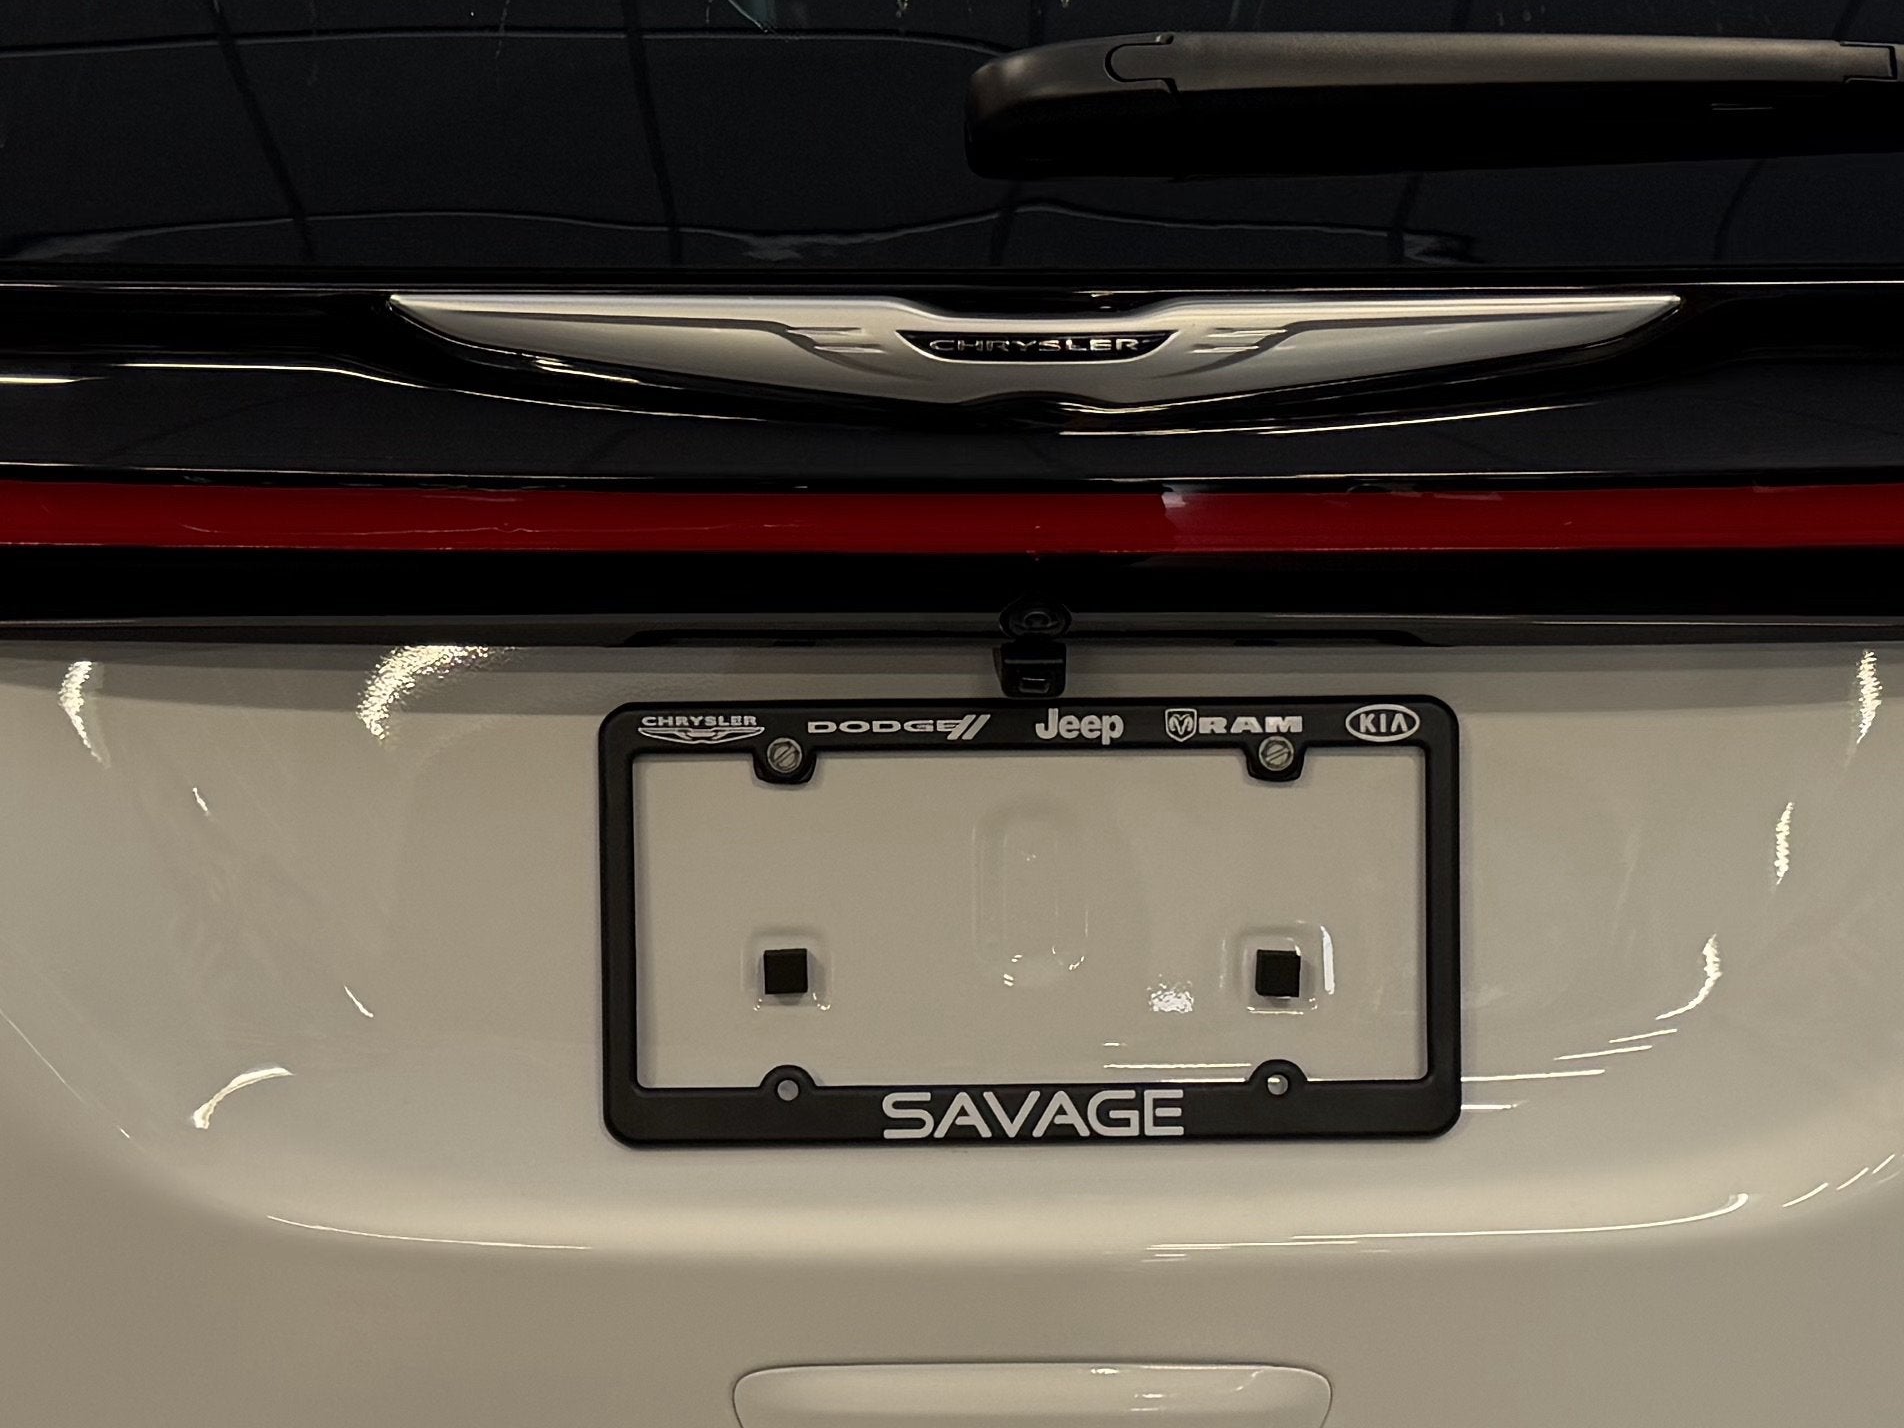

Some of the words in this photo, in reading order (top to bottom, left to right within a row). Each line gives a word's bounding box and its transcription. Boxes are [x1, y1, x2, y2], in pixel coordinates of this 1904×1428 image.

[929, 338, 1141, 353] CHRYSLER
[641, 715, 757, 727] CHRYSLER
[807, 720, 963, 734] DODGE
[1035, 708, 1124, 745] Jeep
[1198, 716, 1304, 733] RAM
[1358, 712, 1409, 734] KIA
[882, 1090, 1185, 1140] SAVAGE
